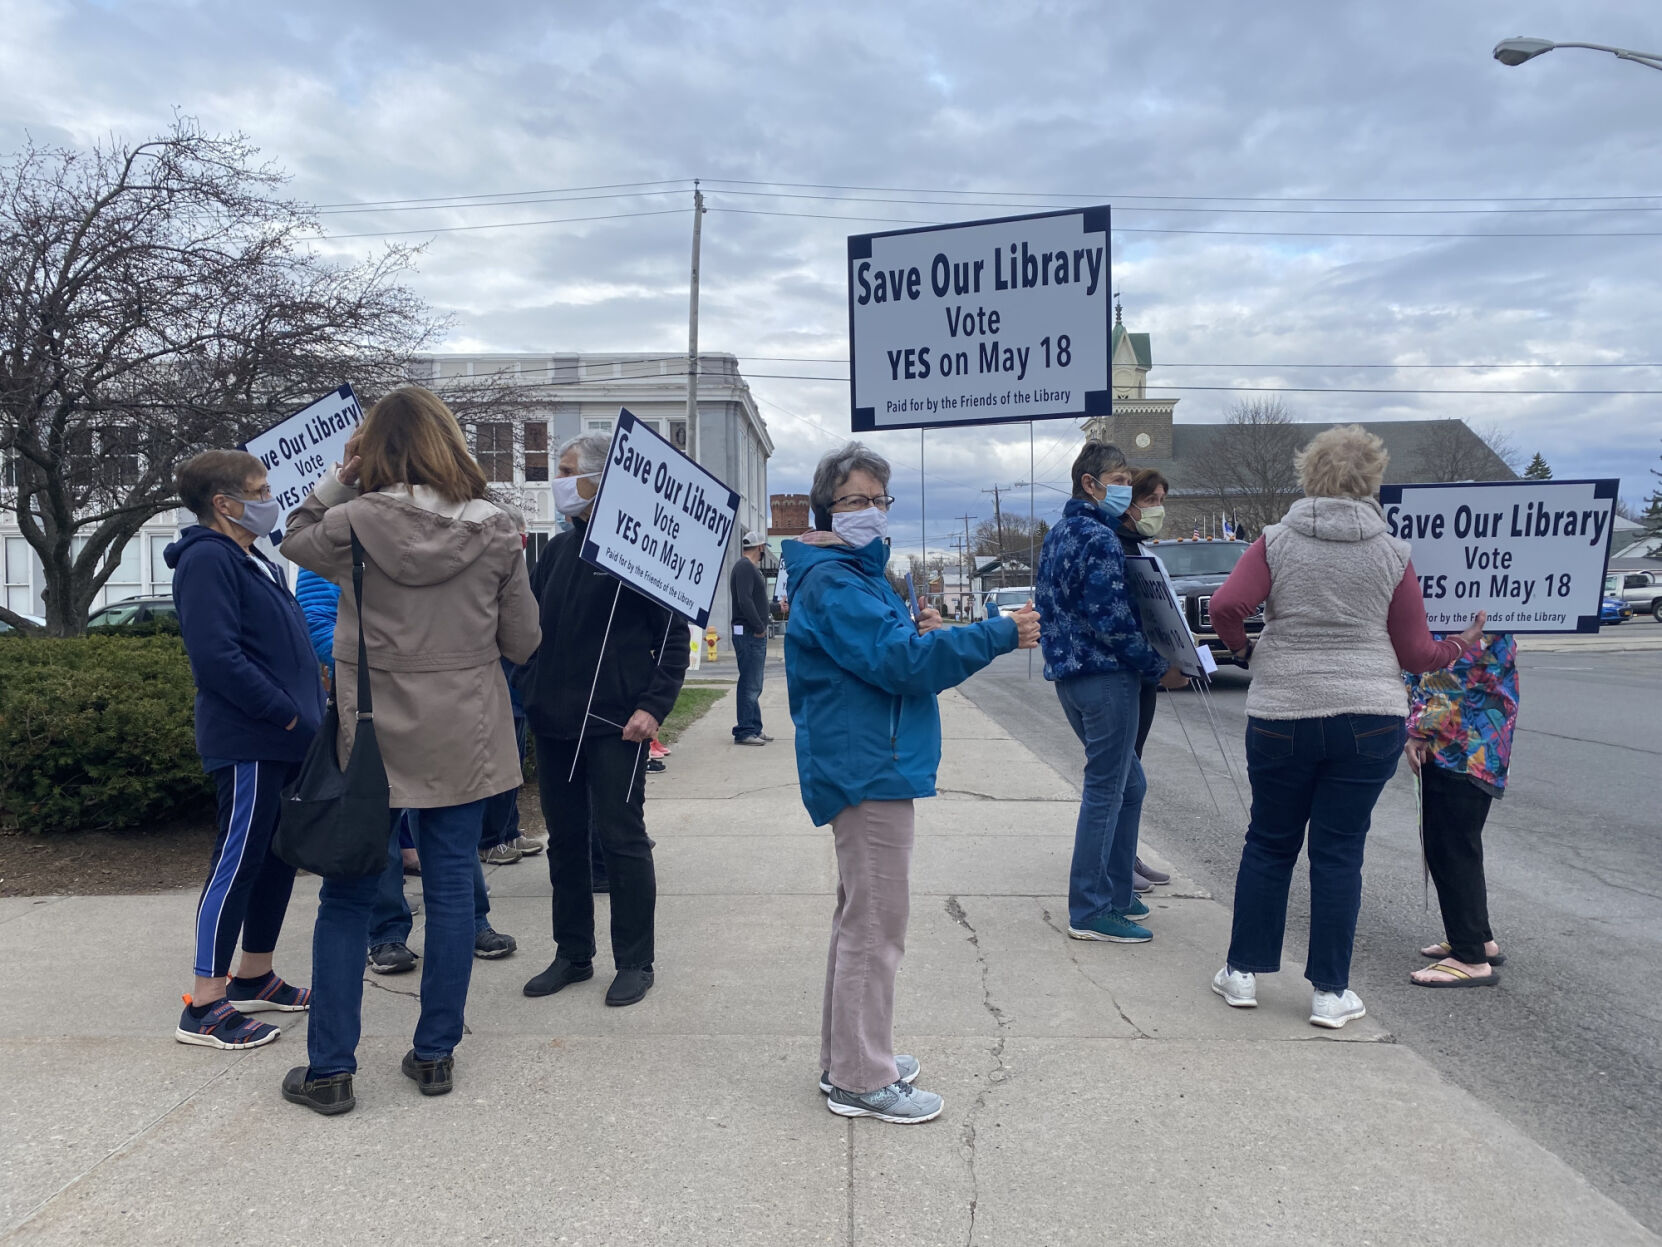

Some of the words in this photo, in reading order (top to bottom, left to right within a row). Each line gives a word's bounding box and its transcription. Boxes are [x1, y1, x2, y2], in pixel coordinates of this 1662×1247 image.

[857, 261, 921, 306] Save
[931, 253, 984, 298] Our
[994, 241, 1103, 296] Library
[945, 305, 1001, 338] Vote
[887, 346, 931, 381] YES
[939, 351, 969, 377] on
[979, 341, 1030, 381] May
[1040, 334, 1072, 369] 18
[886, 399, 907, 413] Paid
[910, 398, 923, 411] for
[926, 397, 938, 414] by
[941, 396, 957, 409] the
[960, 392, 997, 408] Friends
[1000, 390, 1011, 405] of
[1013, 390, 1031, 404] the
[1034, 388, 1071, 404] Library
[260, 450, 280, 471] ve
[279, 432, 307, 461] Our
[305, 403, 360, 445] Library
[294, 454, 324, 477] Vote
[275, 486, 300, 511] YES
[613, 432, 652, 485] Save
[654, 461, 684, 505] Our
[682, 482, 732, 547] Library
[653, 502, 680, 540] Vote
[1386, 506, 1445, 540] Save
[1454, 504, 1504, 539] Our
[1510, 501, 1609, 547] Library
[615, 509, 642, 545] YES
[641, 534, 658, 557] on
[659, 540, 686, 580] May
[688, 558, 704, 585] 18
[1464, 545, 1513, 570] Vote
[606, 547, 619, 562] Paid
[619, 554, 628, 567] for
[627, 560, 635, 574] by
[634, 566, 644, 578] the
[644, 570, 663, 589] Friends
[662, 583, 670, 592] of
[668, 585, 677, 598] the
[677, 591, 695, 610] Library
[1416, 574, 1448, 599] ES
[1454, 580, 1481, 599] on
[1489, 574, 1536, 605] May
[1544, 573, 1571, 598] 18
[1440, 612, 1451, 625] by
[1453, 612, 1468, 622] the
[1505, 612, 1515, 622] of
[1517, 612, 1532, 622] the
[1534, 611, 1566, 624] Library
